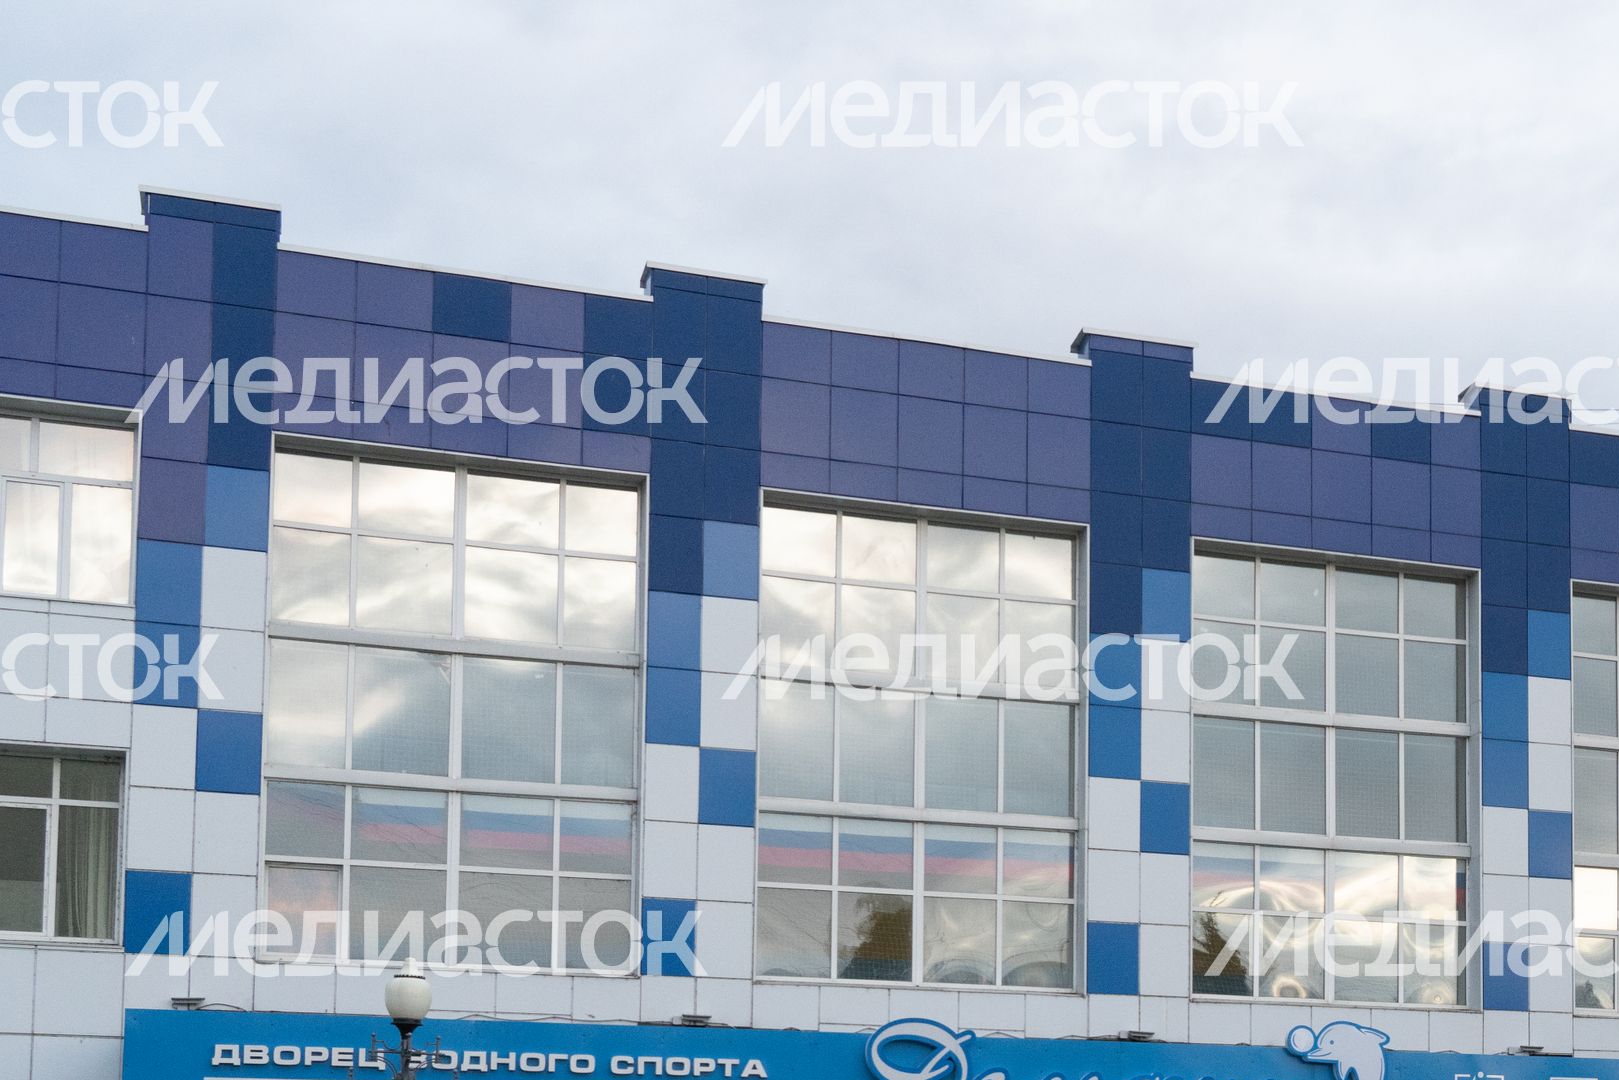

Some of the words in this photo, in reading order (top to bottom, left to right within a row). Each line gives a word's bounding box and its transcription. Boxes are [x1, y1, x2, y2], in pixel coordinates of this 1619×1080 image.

[211, 1043, 387, 1071] ДВОРЕЦ
[407, 1048, 596, 1075] ВОДНОГО
[610, 1055, 768, 1079] СПОРТА
